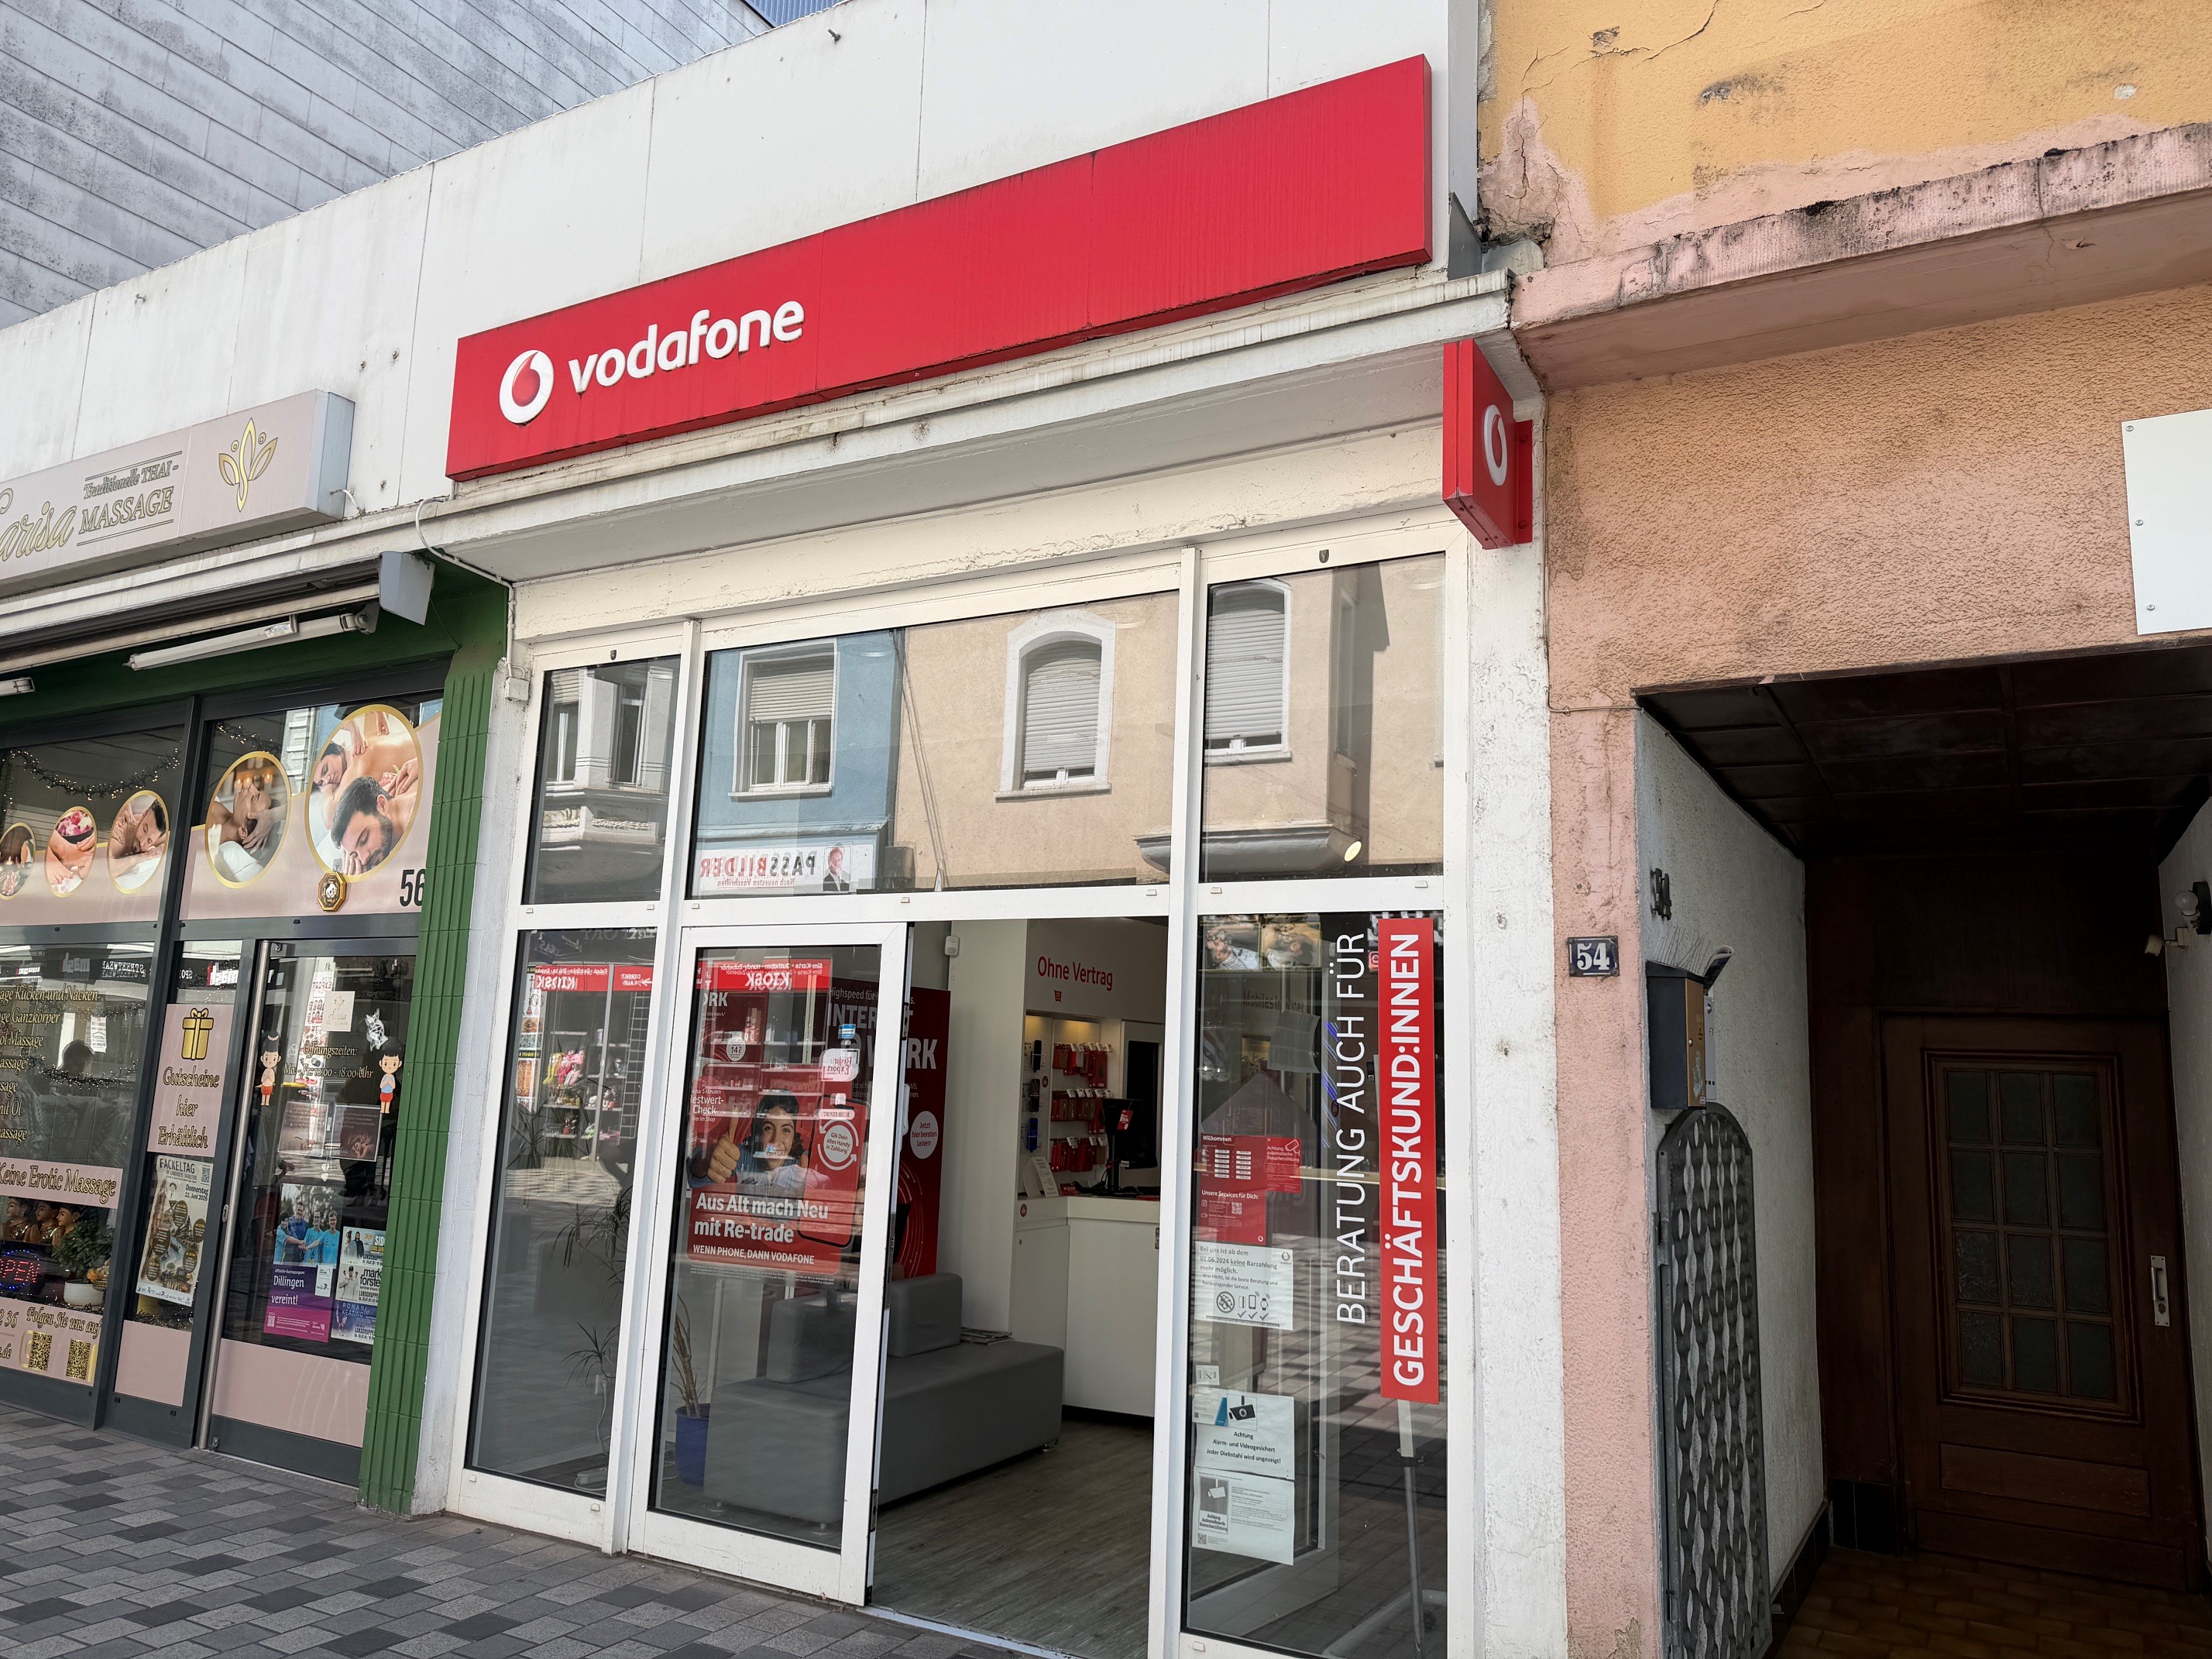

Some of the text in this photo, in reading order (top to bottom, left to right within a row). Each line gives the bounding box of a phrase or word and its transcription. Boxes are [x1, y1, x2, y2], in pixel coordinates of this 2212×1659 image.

[568, 301, 805, 394] vodafone
[84, 468, 139, 499] Traditionelle
[78, 486, 174, 534] MASSAGE
[400, 869, 426, 907] 56
[1576, 943, 1610, 970] 54
[1037, 956, 1113, 991] Ohne Vertrag
[0, 983, 98, 1005] age Rücken und Nacken
[1242, 990, 1273, 1009] Mobiles
[12, 1008, 60, 1029] Ganzkörper
[303, 1040, 358, 1059] Öffnungszeiten:
[0, 1059, 26, 1075] assage
[163, 1065, 220, 1087] Gutscheine
[283, 1063, 297, 1074] Mo.
[0, 1081, 18, 1098] sage
[12, 1097, 22, 1115] Öl
[176, 1094, 198, 1117] hier
[692, 1104, 716, 1115] Check
[919, 1121, 931, 1130] Jetzt
[1329, 933, 1366, 1323] BERATUNG AUCH FÜR
[0, 1130, 27, 1146] assage
[157, 1124, 208, 1148] Erhältlich
[160, 1158, 195, 1174] FACKELTAG
[1385, 934, 1424, 1386] GESCHÄFTSKUND:INNEN
[29, 1165, 64, 1190] Erotic
[64, 1169, 117, 1204] Massage
[185, 1183, 209, 1197] Donnerstag
[696, 1192, 829, 1219] Aus Alt mach Neu
[694, 1217, 795, 1243] mit Re-trade
[693, 1244, 815, 1265] WENN PHONE, DANN VODAFONE
[0, 1259, 40, 1283] PEN
[363, 1268, 382, 1279] mark
[1246, 1260, 1278, 1269] Barzahlung
[273, 1275, 304, 1290] Dillingen
[360, 1274, 380, 1287] forste
[271, 1293, 298, 1305] vereint!
[359, 1290, 379, 1299] LOKSCHUPPE
[26, 1307, 53, 1326] Folgen
[53, 1311, 68, 1328] Sie
[70, 1316, 84, 1331] uns
[342, 1309, 363, 1317] KEATING
[355, 1327, 375, 1335] LOKSCHUPPE
[1234, 1431, 1254, 1440] Achtung
[1220, 1450, 1243, 1458] Diebstahl
[1239, 1442, 1276, 1452] Videogesichert
